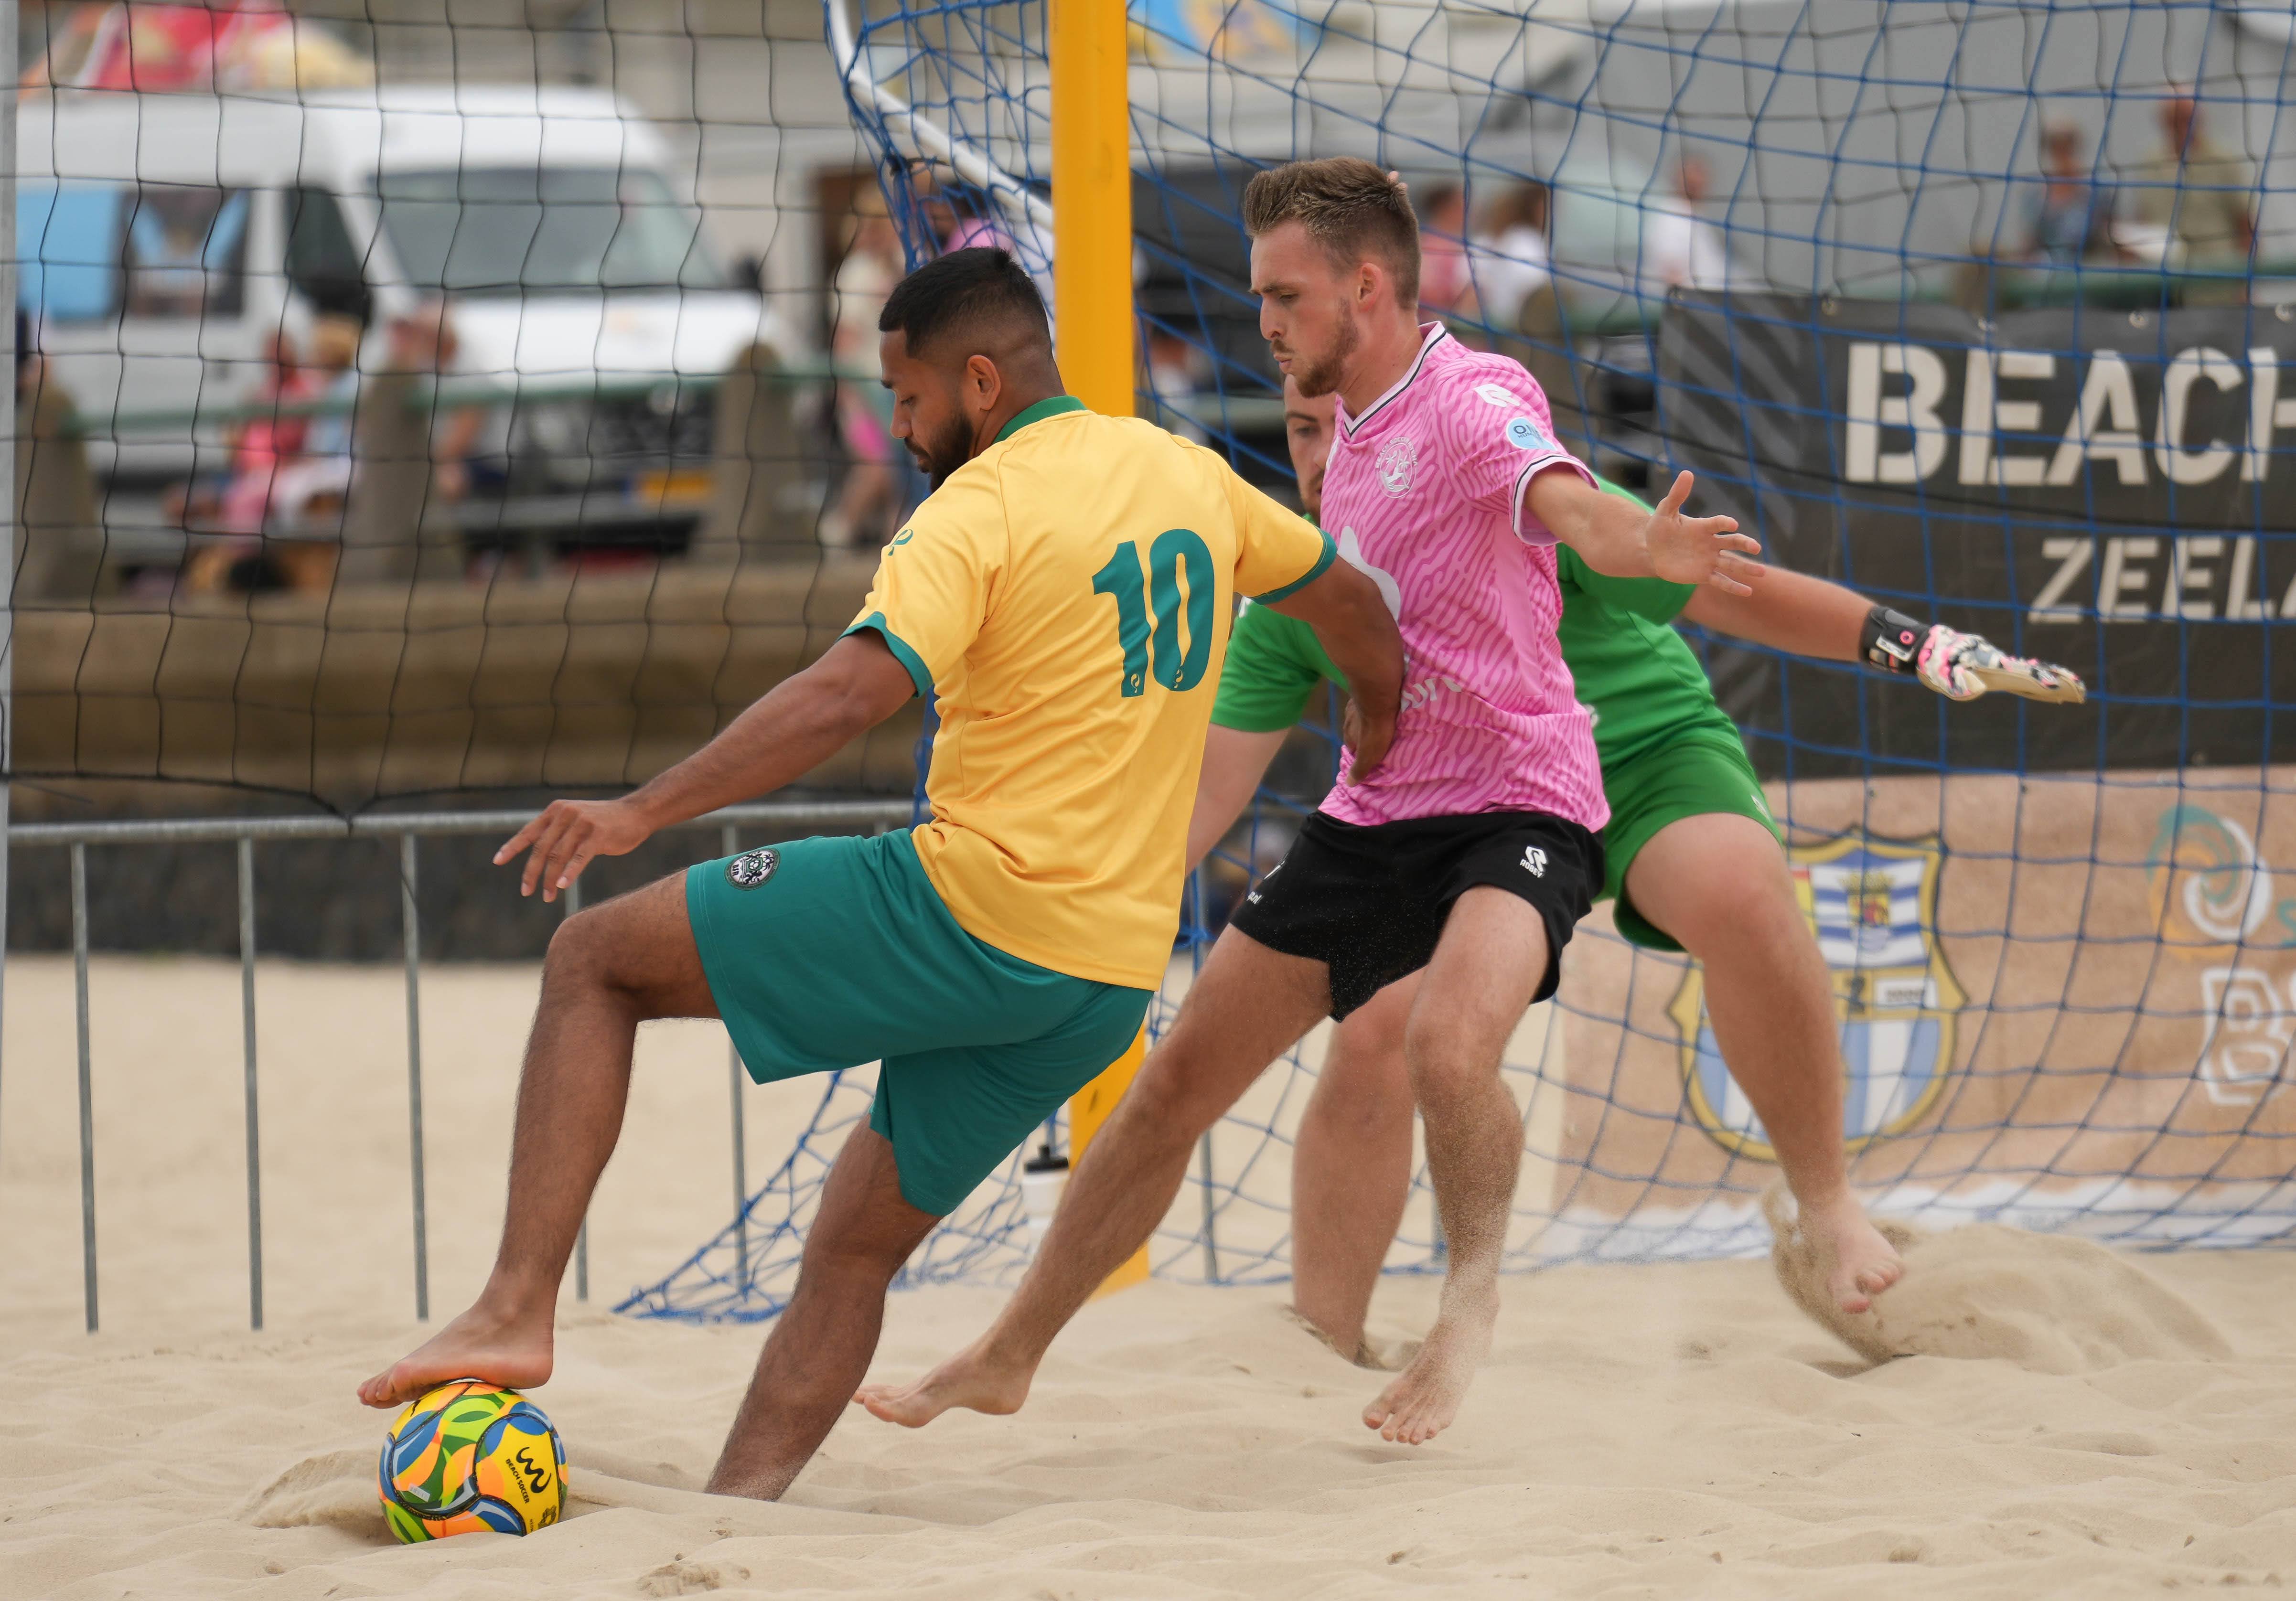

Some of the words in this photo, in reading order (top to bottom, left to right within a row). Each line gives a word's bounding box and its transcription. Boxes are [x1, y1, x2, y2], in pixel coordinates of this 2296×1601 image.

[1846, 343, 2296, 486] BEACH
[1092, 528, 1215, 698] 10
[2027, 534, 2296, 624] ZEEL
[1520, 859, 1543, 878] ROBEY
[505, 1458, 520, 1480] BEACH
[517, 1480, 530, 1504] SOCCER
